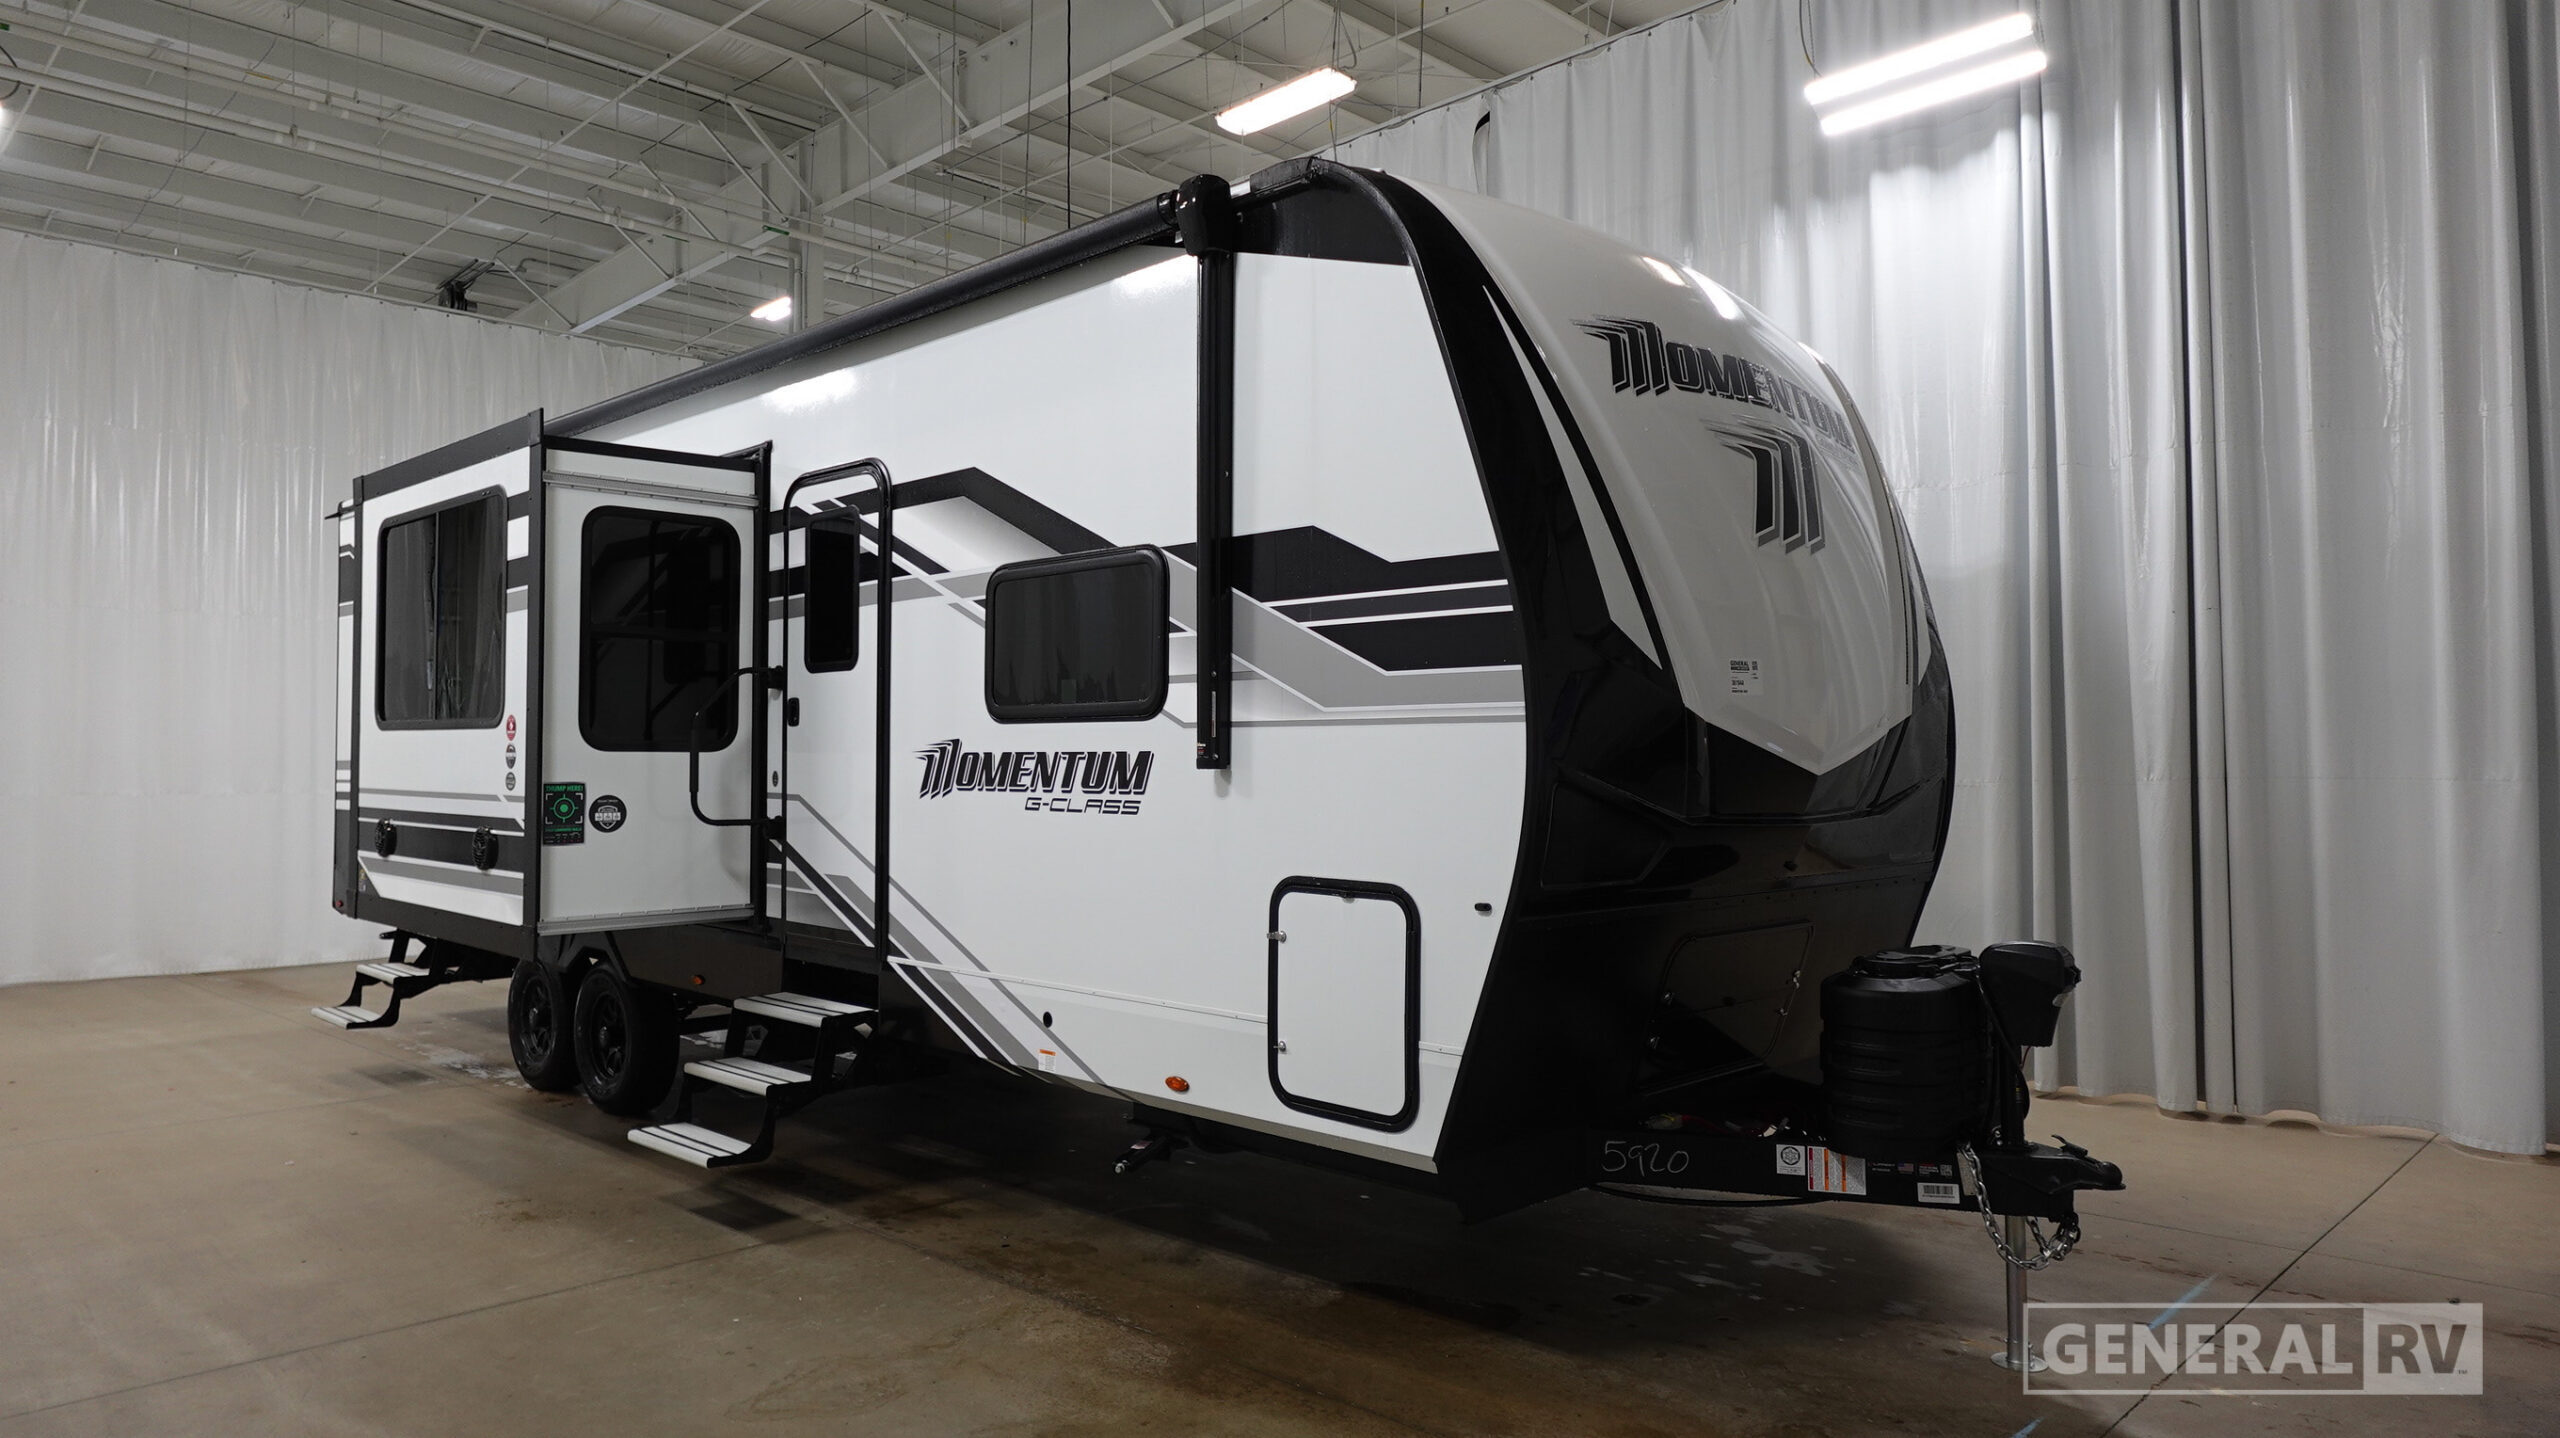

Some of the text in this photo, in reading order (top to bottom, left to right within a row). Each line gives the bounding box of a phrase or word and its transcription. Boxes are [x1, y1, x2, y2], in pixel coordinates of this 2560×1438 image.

[1571, 315, 1856, 455] MOMENTUM
[913, 738, 1155, 799] MOMENTUM
[1025, 797, 1142, 816] G-CLASS
[1601, 1140, 1690, 1177] 5920
